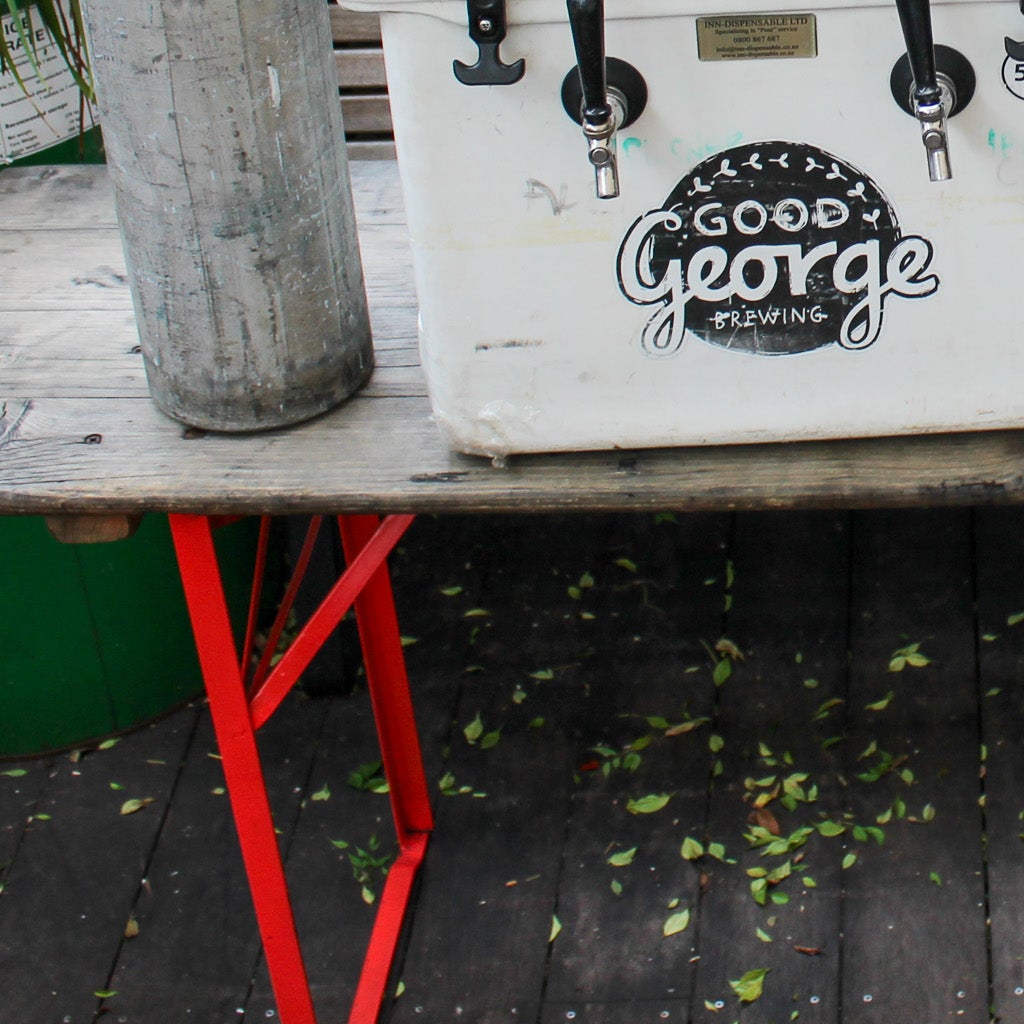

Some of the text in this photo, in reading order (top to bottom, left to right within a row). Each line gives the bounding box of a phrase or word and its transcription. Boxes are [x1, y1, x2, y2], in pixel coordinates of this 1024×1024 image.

[704, 17, 808, 29] INN-DISPENSABLE LTD
[693, 197, 849, 237] GOOD
[616, 206, 941, 358] George
[713, 304, 826, 330] BREWING
